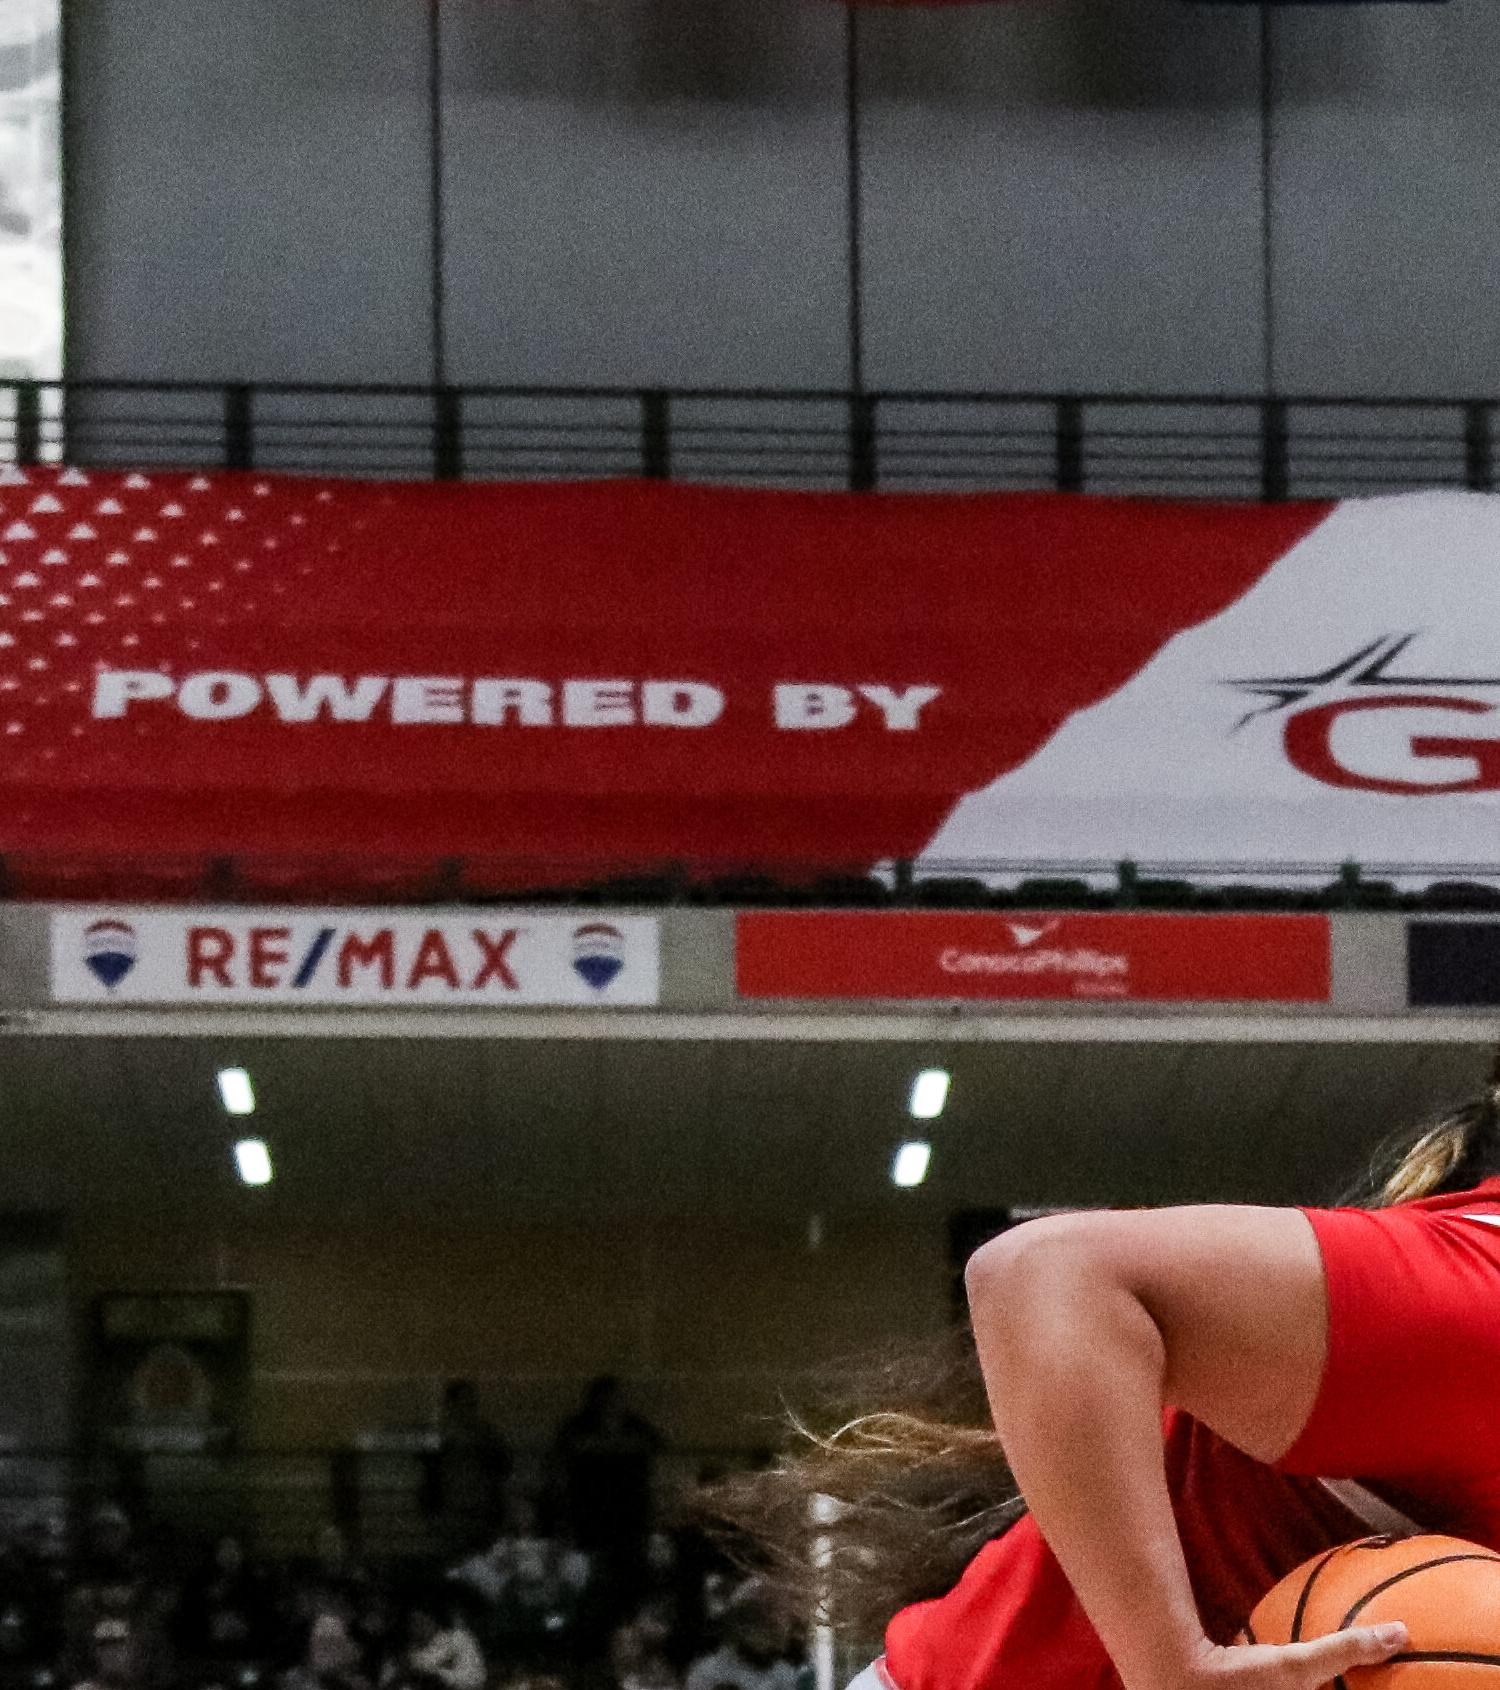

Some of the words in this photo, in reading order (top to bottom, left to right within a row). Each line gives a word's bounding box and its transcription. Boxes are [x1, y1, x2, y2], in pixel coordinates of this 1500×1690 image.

[91, 669, 726, 728] POWERED
[772, 682, 944, 731] BY
[185, 925, 522, 990] RE/MAX
